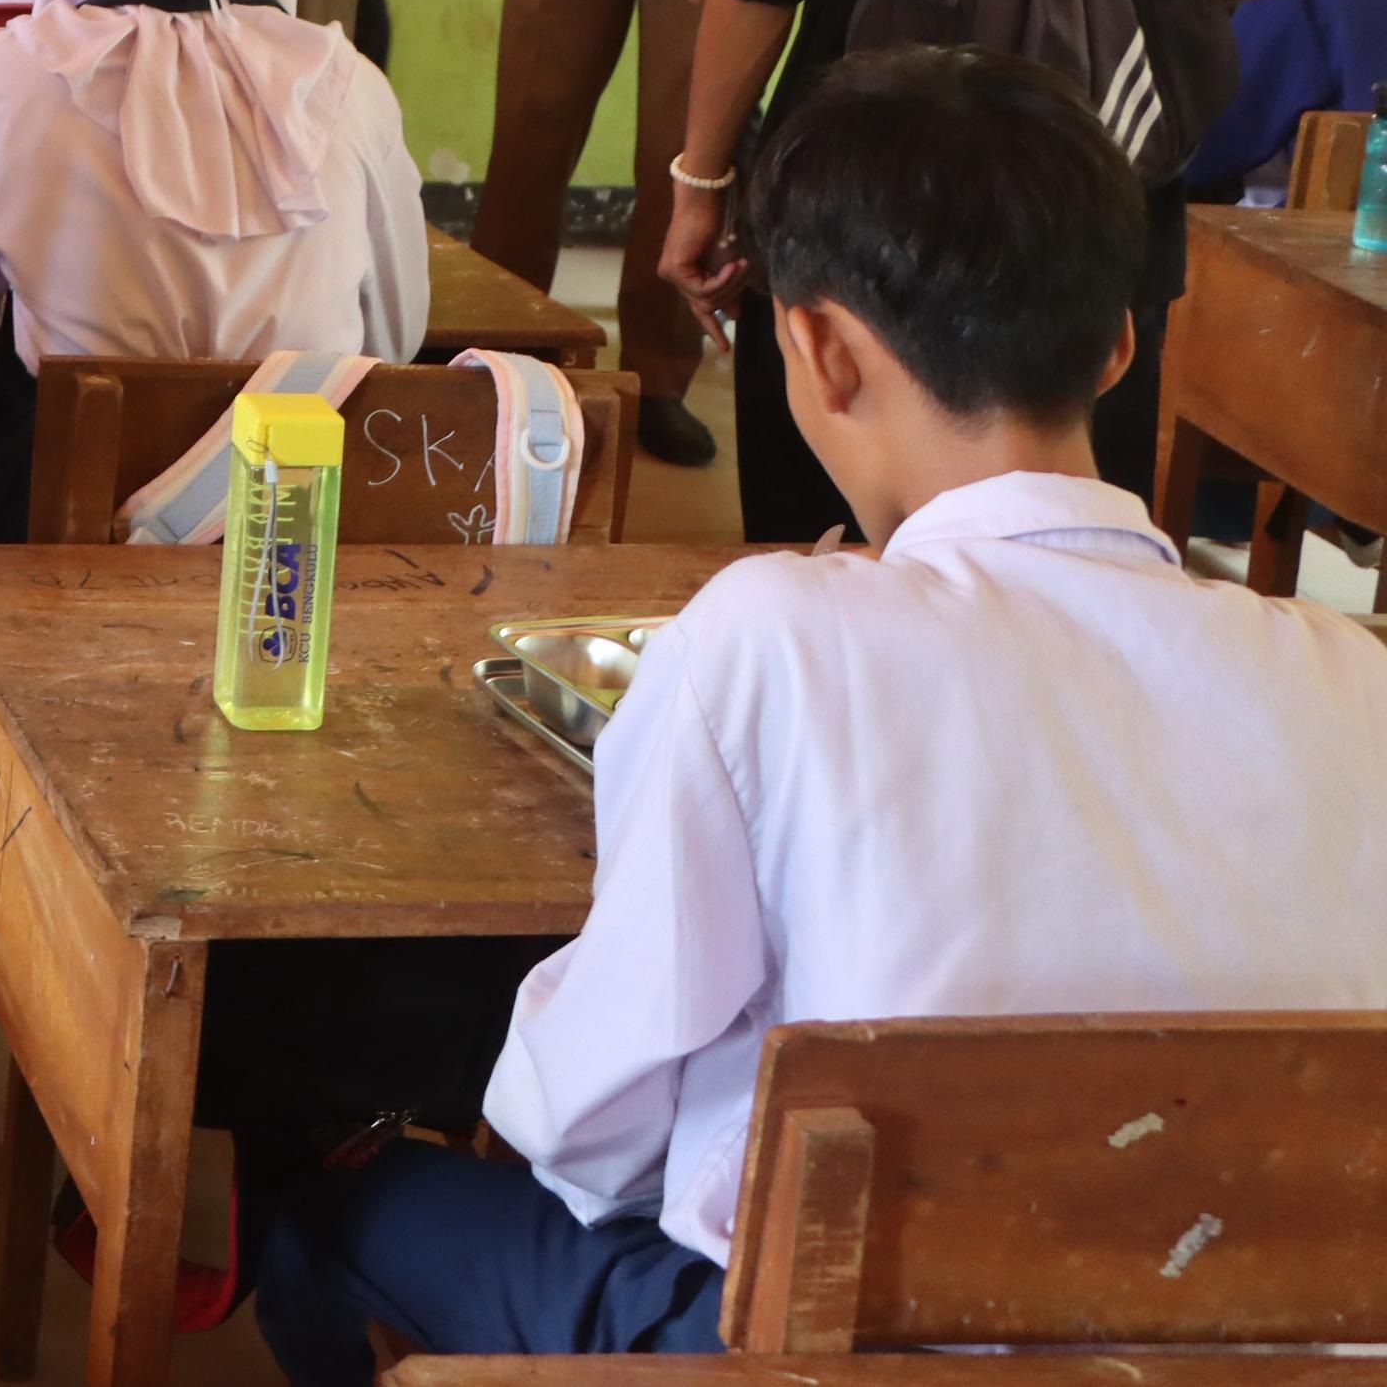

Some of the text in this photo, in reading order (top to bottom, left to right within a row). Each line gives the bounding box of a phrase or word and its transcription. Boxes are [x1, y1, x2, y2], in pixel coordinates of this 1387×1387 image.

[266, 543, 302, 620] BCA
[299, 544, 319, 663] KCU BENGKULU
